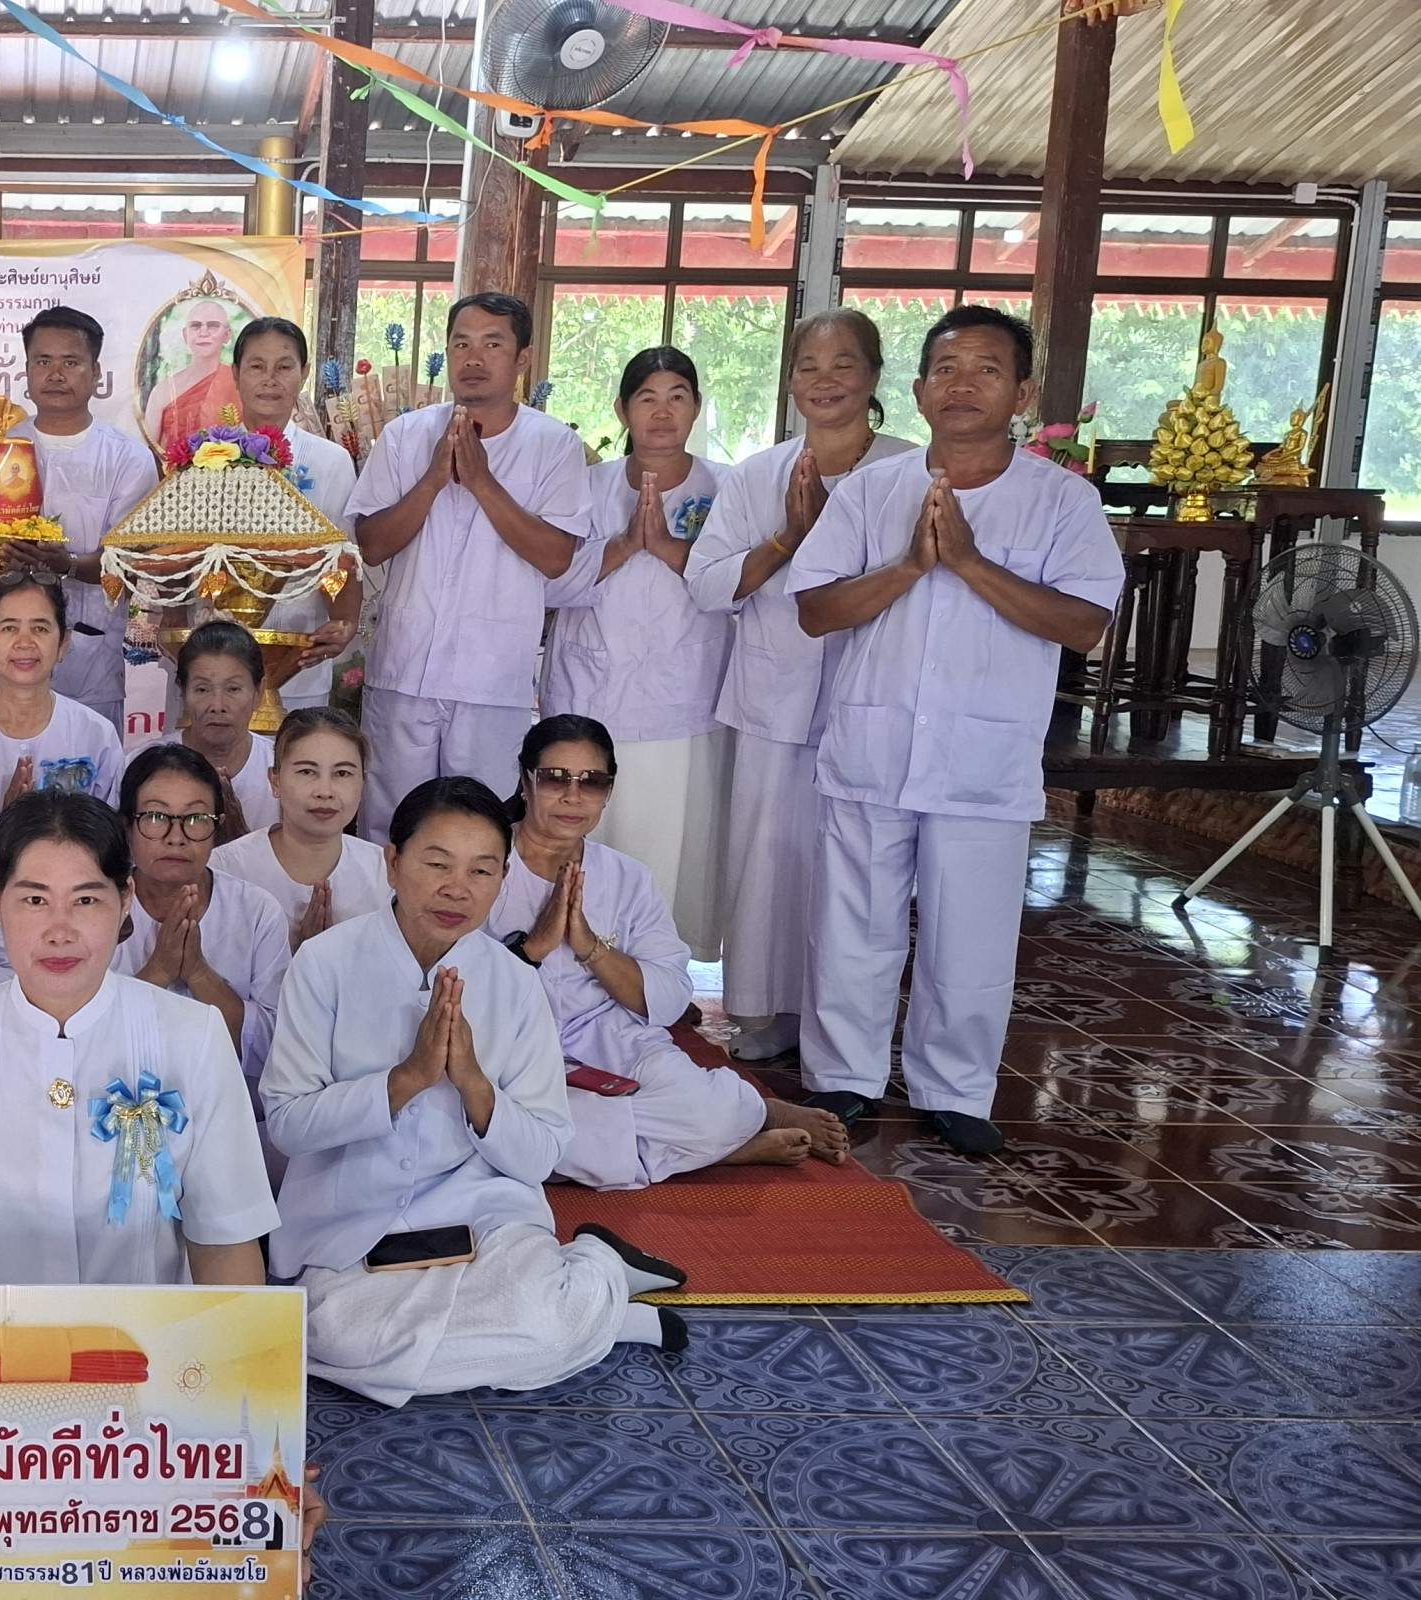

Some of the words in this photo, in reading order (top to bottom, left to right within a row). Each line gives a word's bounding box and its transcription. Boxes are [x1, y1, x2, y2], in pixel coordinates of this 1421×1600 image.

[170, 1501, 271, 1539] 2568
[120, 1558, 266, 1580] หลวงพ่อธัมมชโย
